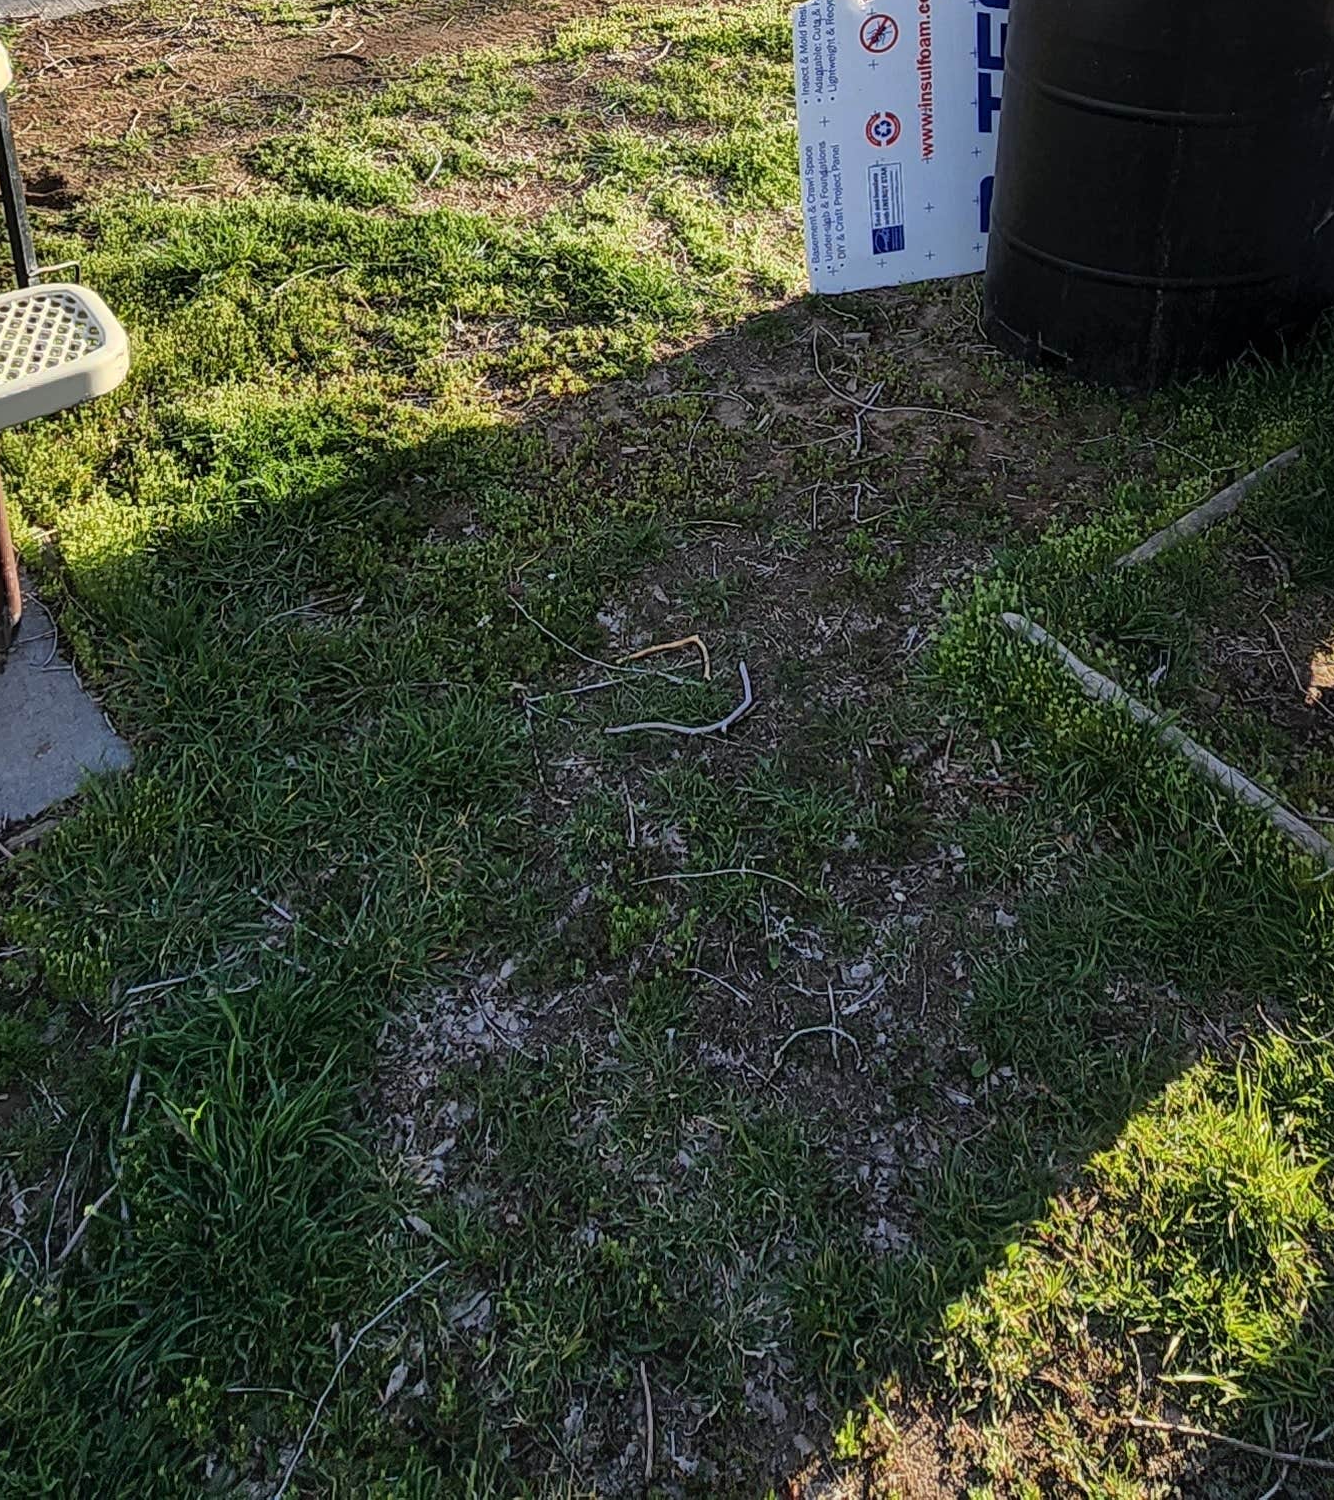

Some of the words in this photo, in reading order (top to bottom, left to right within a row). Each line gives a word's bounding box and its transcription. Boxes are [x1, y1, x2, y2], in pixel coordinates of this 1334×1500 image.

[798, 30, 808, 54] Mold
[826, 27, 835, 35] &
[799, 56, 808, 64] &
[813, 43, 825, 94] Adaptable:
[827, 38, 838, 93] Lightweight
[800, 67, 809, 95] Insect
[804, 145, 816, 176] Space
[817, 141, 829, 199] Foundations
[830, 144, 840, 171] Panel
[806, 177, 816, 203] Crawl
[832, 173, 843, 206] Project
[807, 205, 816, 213] &
[820, 201, 829, 209] &
[834, 208, 844, 232] Craft
[808, 216, 820, 264] Basement
[821, 211, 834, 262] Under-slab
[836, 233, 845, 241] &
[837, 243, 847, 260] DIY
